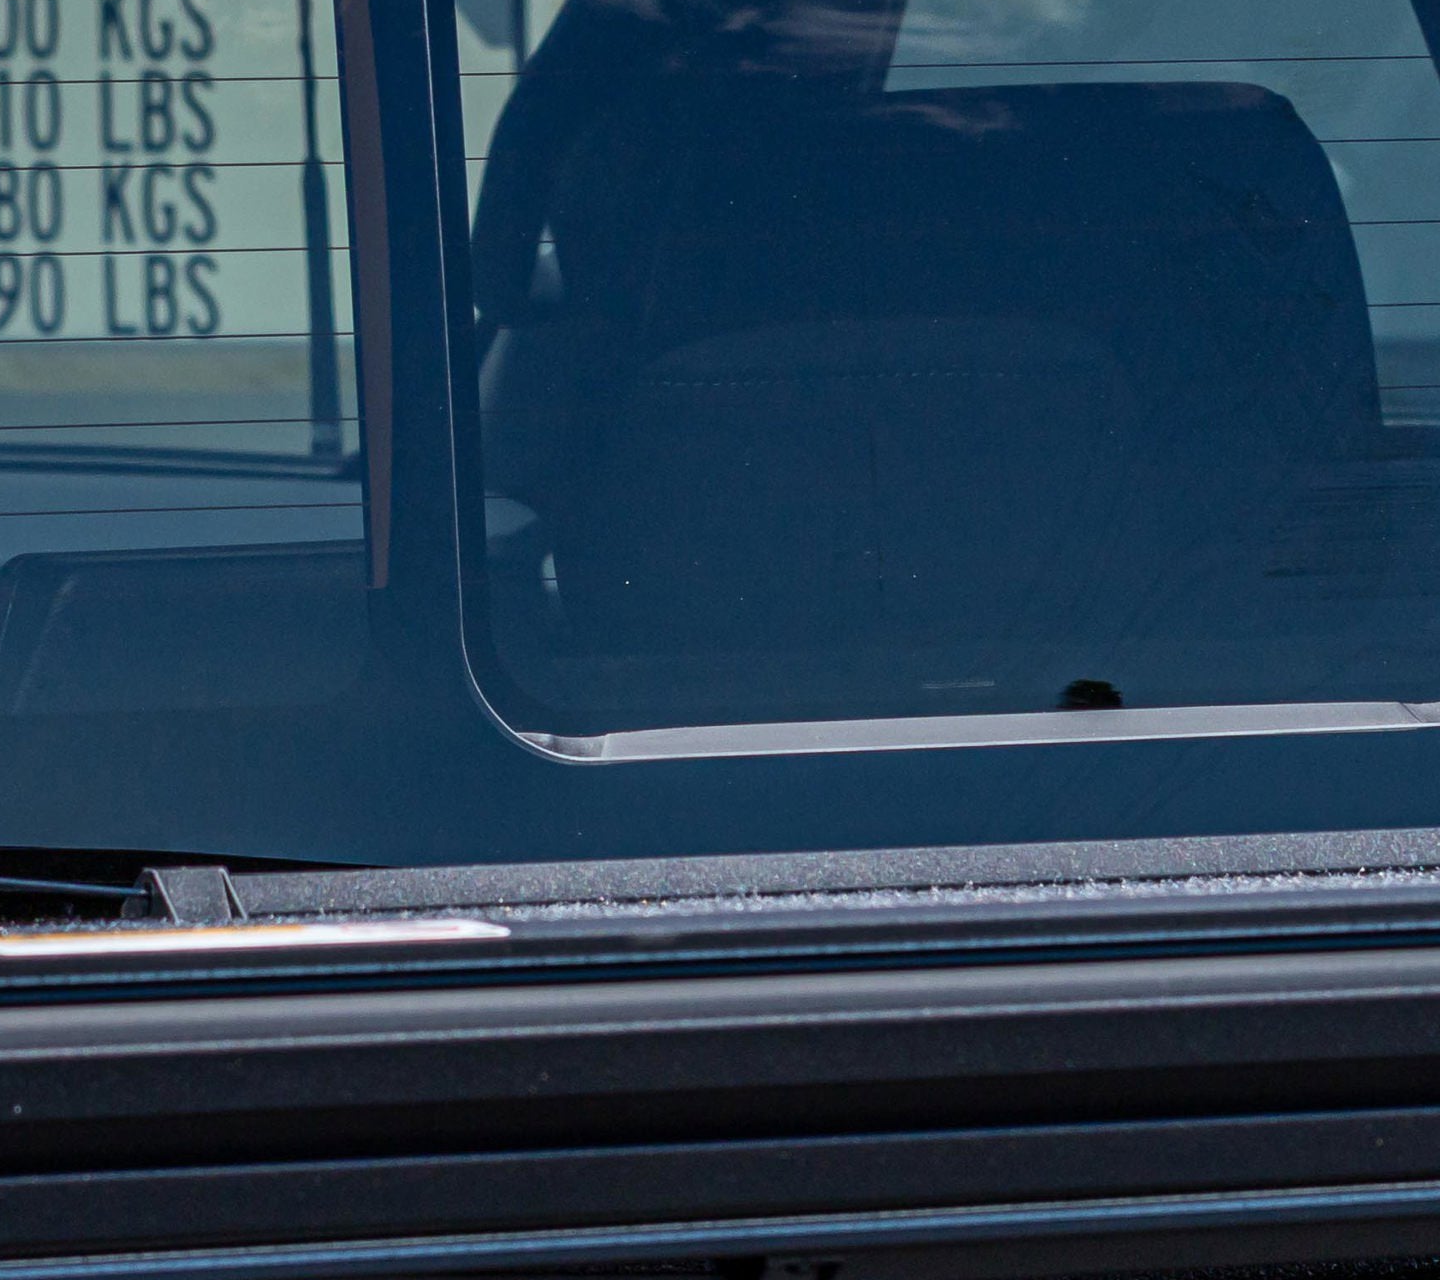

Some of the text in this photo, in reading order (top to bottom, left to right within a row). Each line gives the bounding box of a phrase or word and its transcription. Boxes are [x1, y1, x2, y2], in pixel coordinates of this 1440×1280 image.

[98, 68, 217, 154] LBS
[100, 161, 219, 245] KGS
[101, 251, 221, 337] LBS
